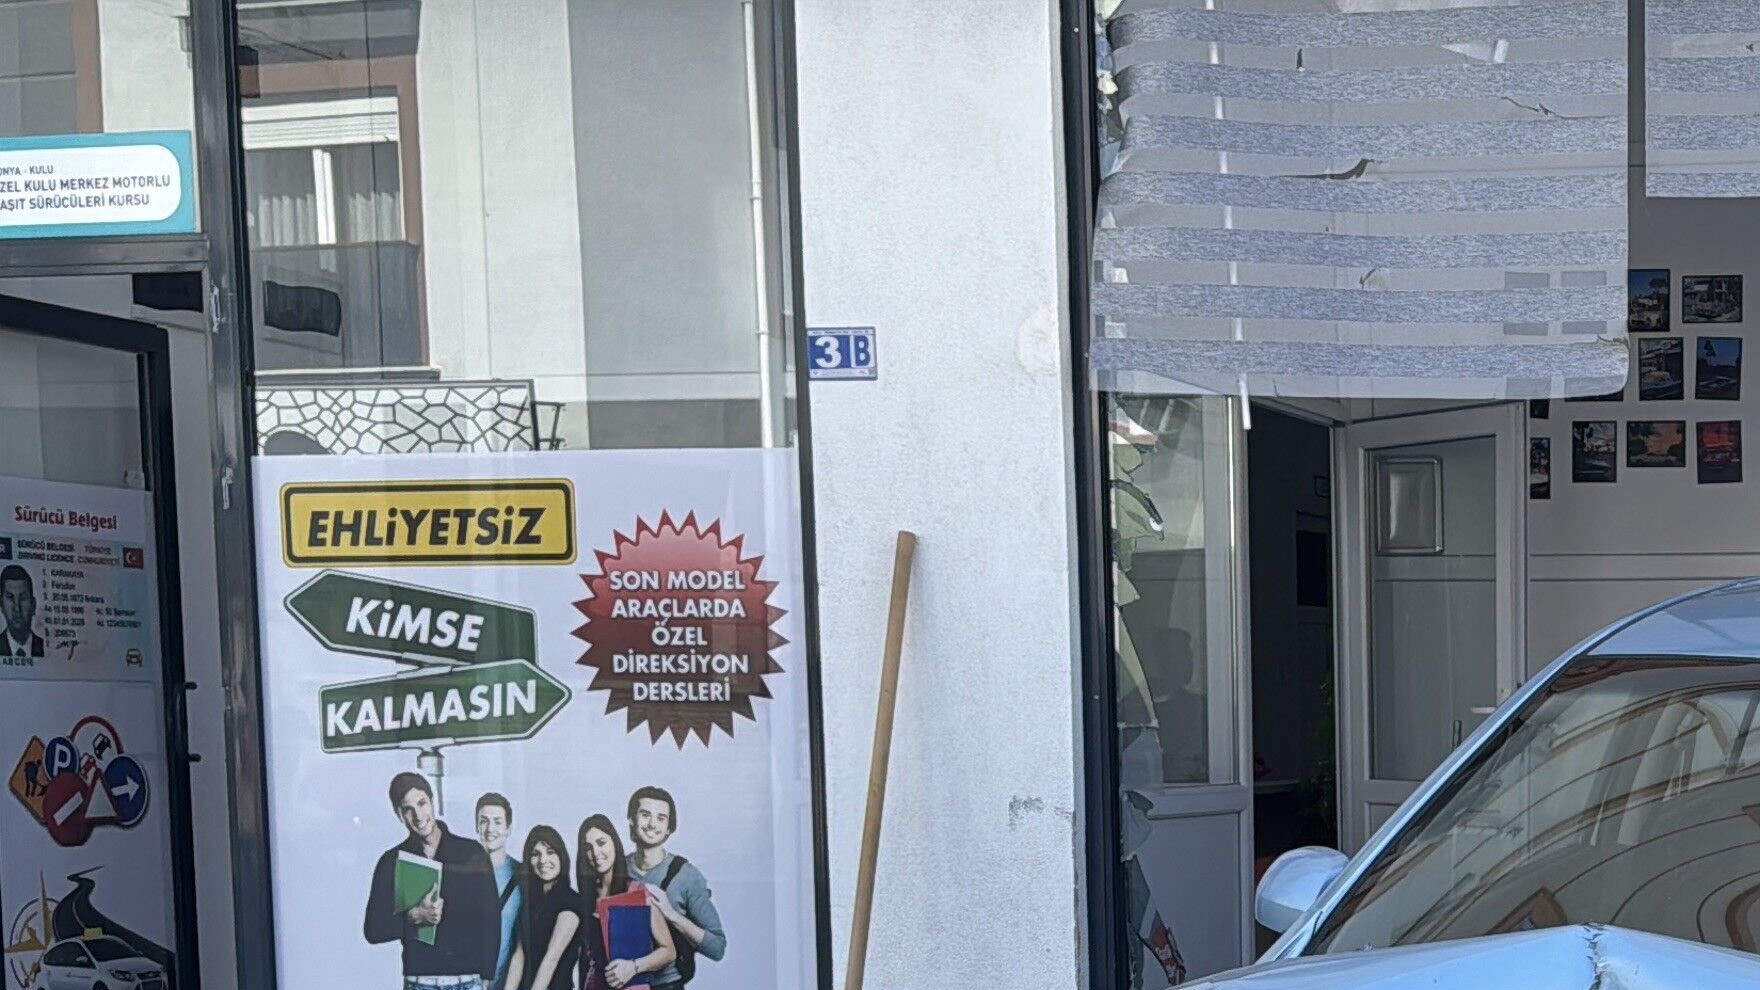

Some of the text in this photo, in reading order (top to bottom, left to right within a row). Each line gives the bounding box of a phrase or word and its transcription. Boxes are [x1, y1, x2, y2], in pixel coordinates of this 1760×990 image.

[29, 165, 54, 175] KULU
[0, 175, 170, 193] ZEL KULU MERKEZ MOTORLU
[0, 193, 150, 212] AŞIT SÜRÜCÜLERİ KURSU
[815, 335, 871, 369] 3 B
[15, 505, 117, 532] Sürücü Belgesi
[610, 571, 745, 590] SON MODEL
[612, 599, 746, 623] ARAÇLARDA
[651, 622, 708, 646] ÖZEL
[613, 652, 749, 674] DİREKSİYON
[633, 681, 731, 702] DERSLERİ
[326, 680, 537, 738] KALMASIN
